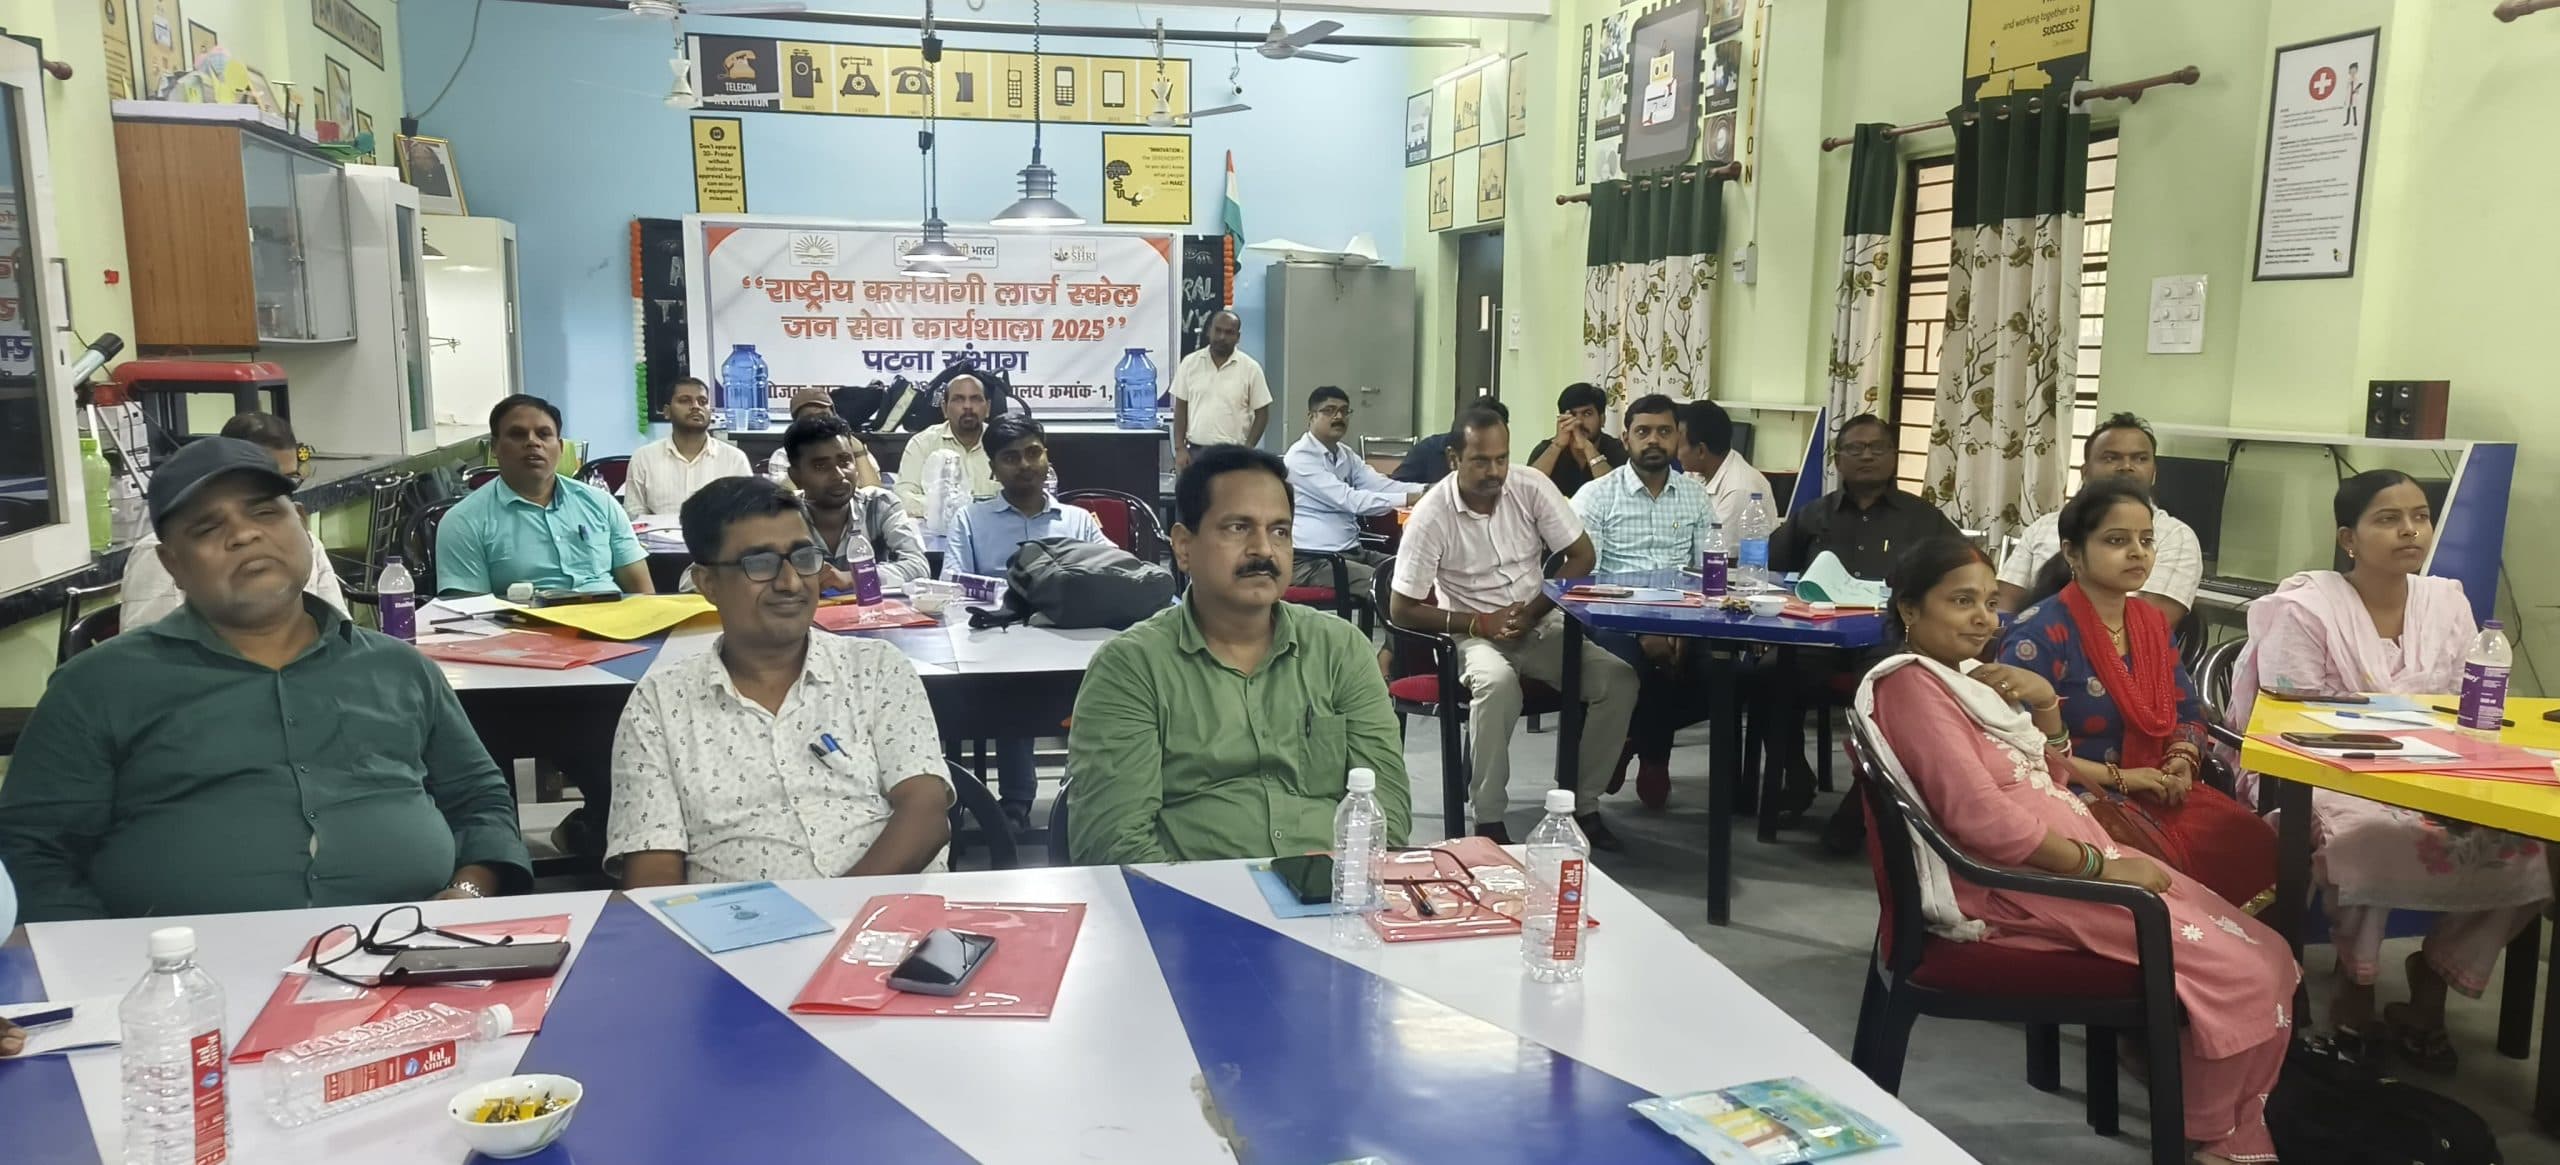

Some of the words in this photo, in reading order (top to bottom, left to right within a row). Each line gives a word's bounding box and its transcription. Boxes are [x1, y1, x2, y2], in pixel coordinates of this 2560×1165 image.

[2003, 18, 2015, 31] and
[2040, 7, 2068, 23] together
[725, 81, 758, 92] TELECOM
[1576, 27, 1592, 182] PROBLEM
[971, 245, 995, 256] भारत
[1072, 251, 1096, 263] SHRI
[993, 274, 1060, 306] लार्ज
[1067, 275, 1141, 308] स्केल
[781, 316, 840, 339] जन
[846, 308, 905, 340] सेवा
[912, 308, 1044, 341] कार्यशाला
[862, 350, 935, 374] पटना
[942, 342, 1029, 374] संभाग
[1563, 869, 1575, 884] Jal
[196, 1045, 211, 1067] Jal
[420, 1055, 452, 1073] Amrit
[425, 1047, 446, 1063] Jal
